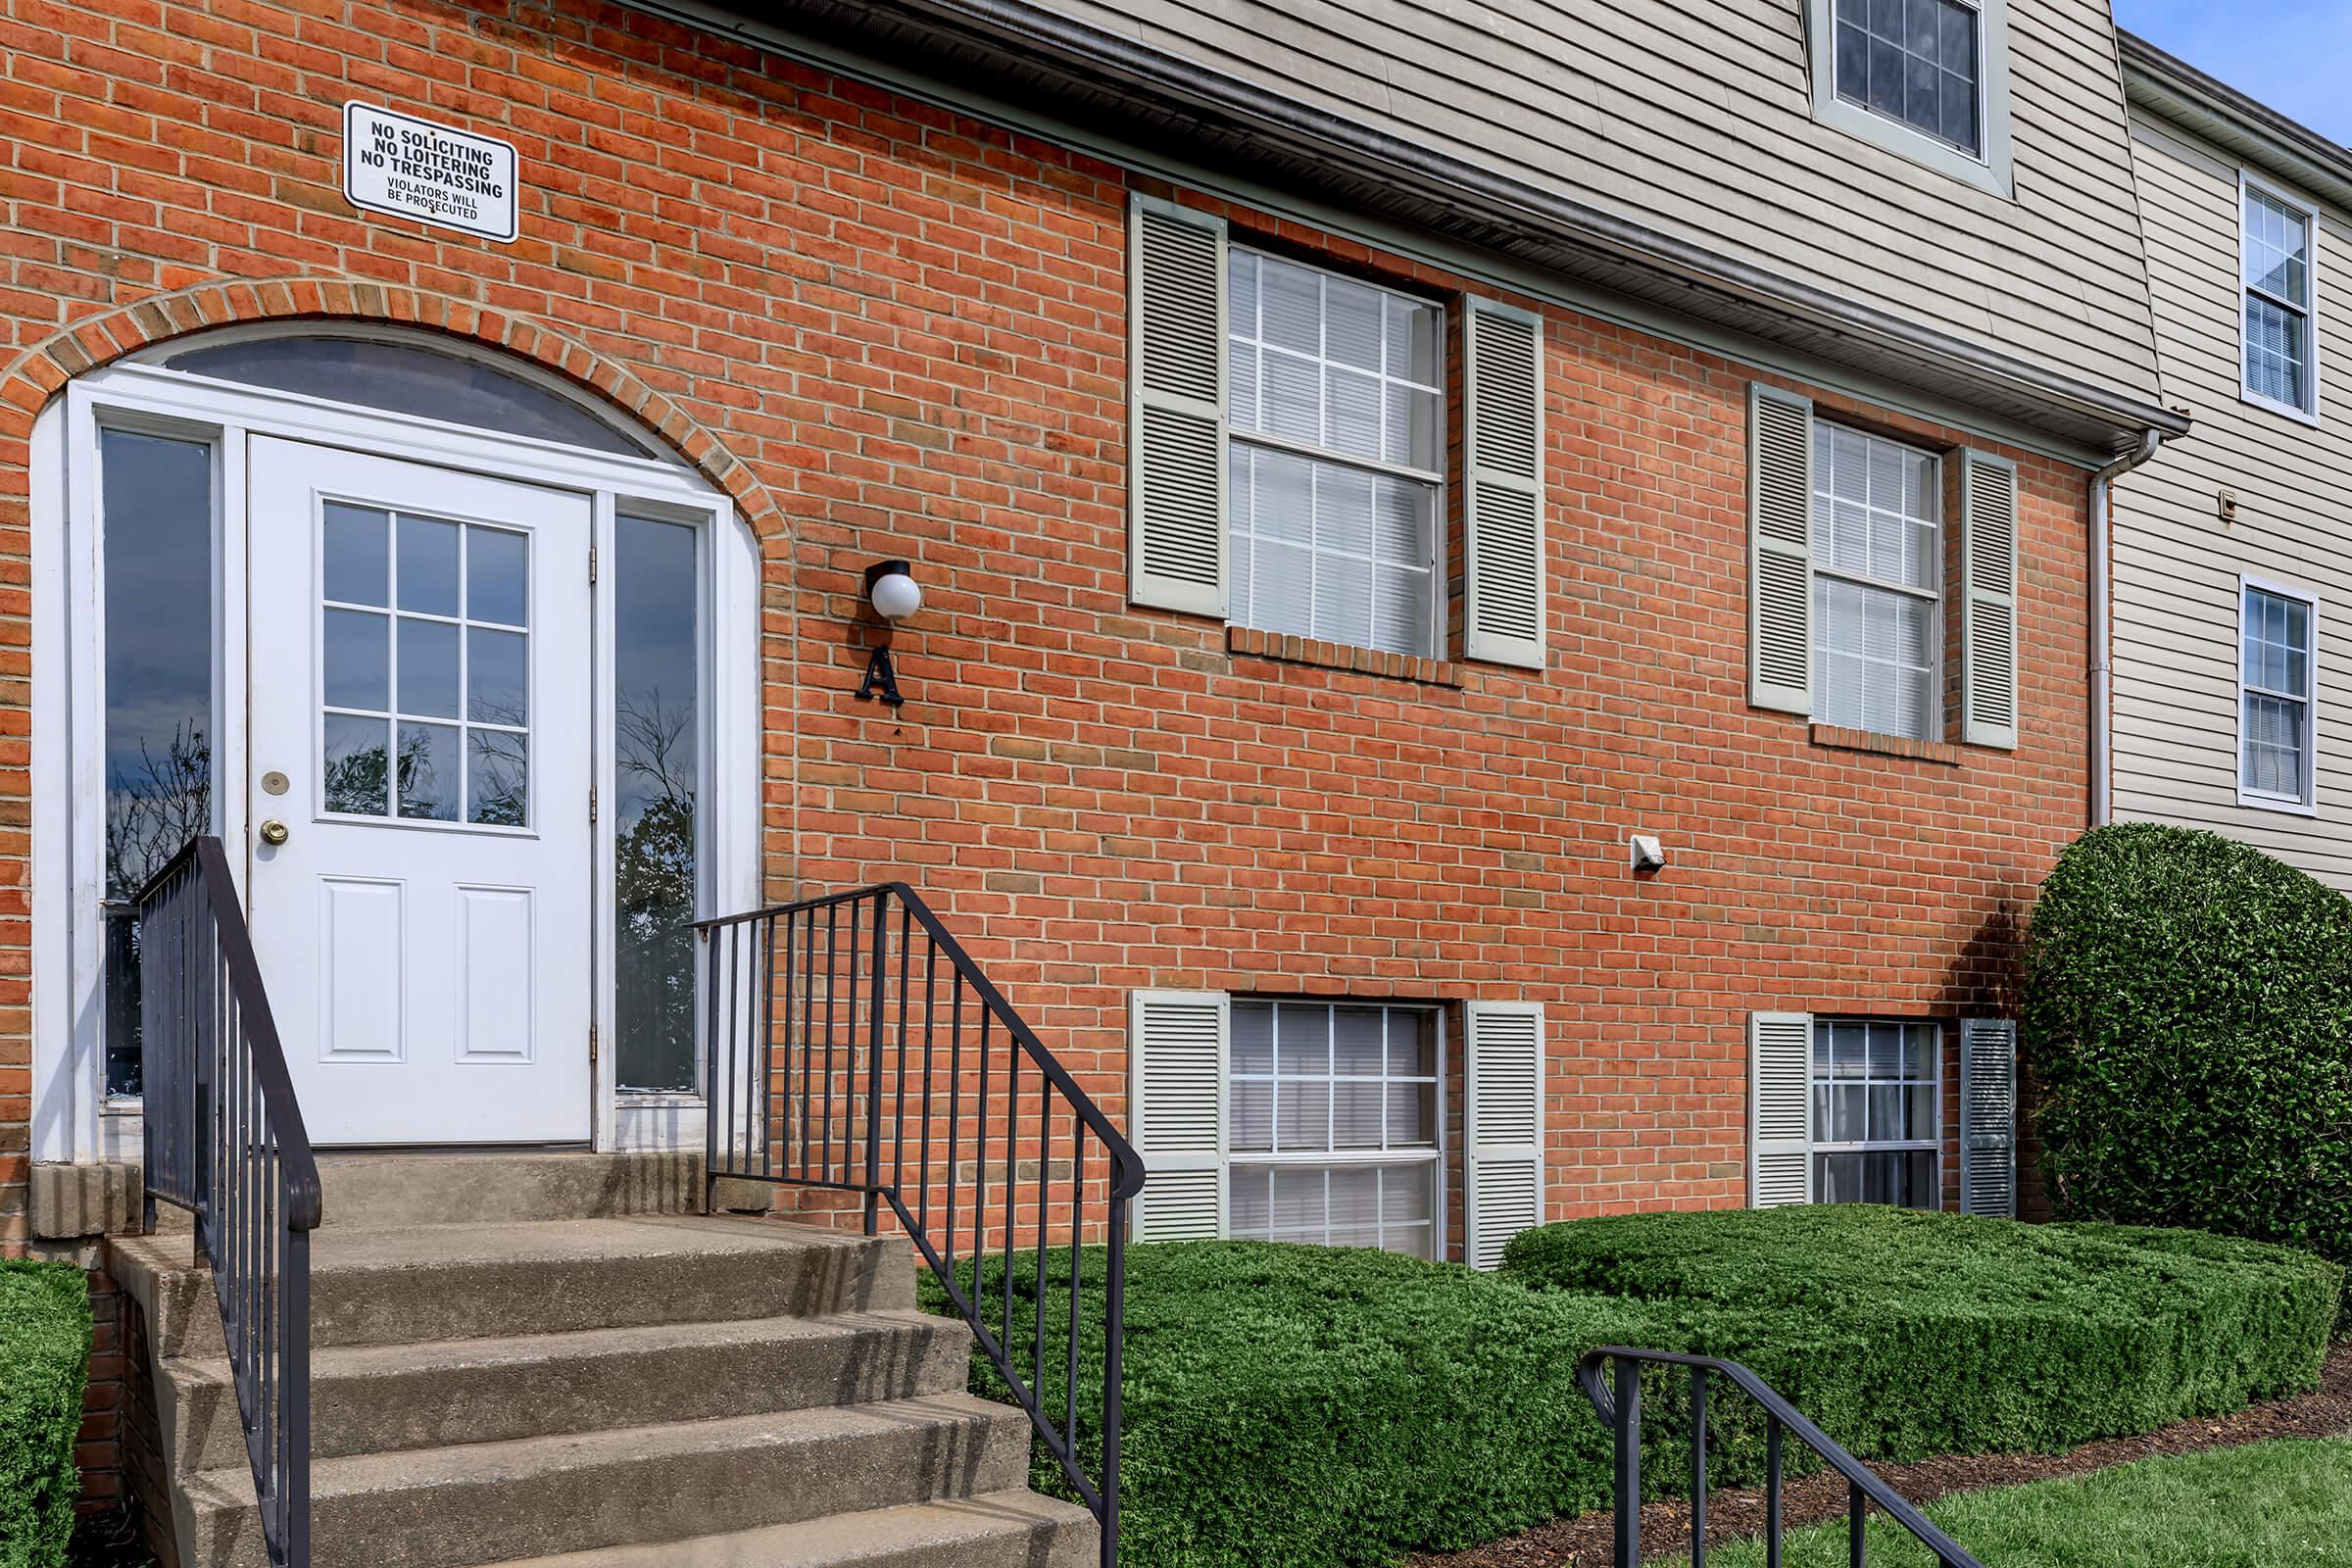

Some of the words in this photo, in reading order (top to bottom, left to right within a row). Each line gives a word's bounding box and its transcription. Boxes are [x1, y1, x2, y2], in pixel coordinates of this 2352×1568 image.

[371, 122, 395, 140] NO
[401, 129, 493, 166] SOLICITING
[374, 137, 398, 156] NO
[404, 145, 490, 180] LOITERING
[361, 150, 384, 168] NO
[390, 157, 503, 199] TRESPASSING
[387, 176, 449, 201] VIOLATORS
[452, 193, 478, 209] WILL
[387, 188, 402, 202] BE
[406, 192, 477, 220] PROSECUTED
[855, 645, 905, 707] A
